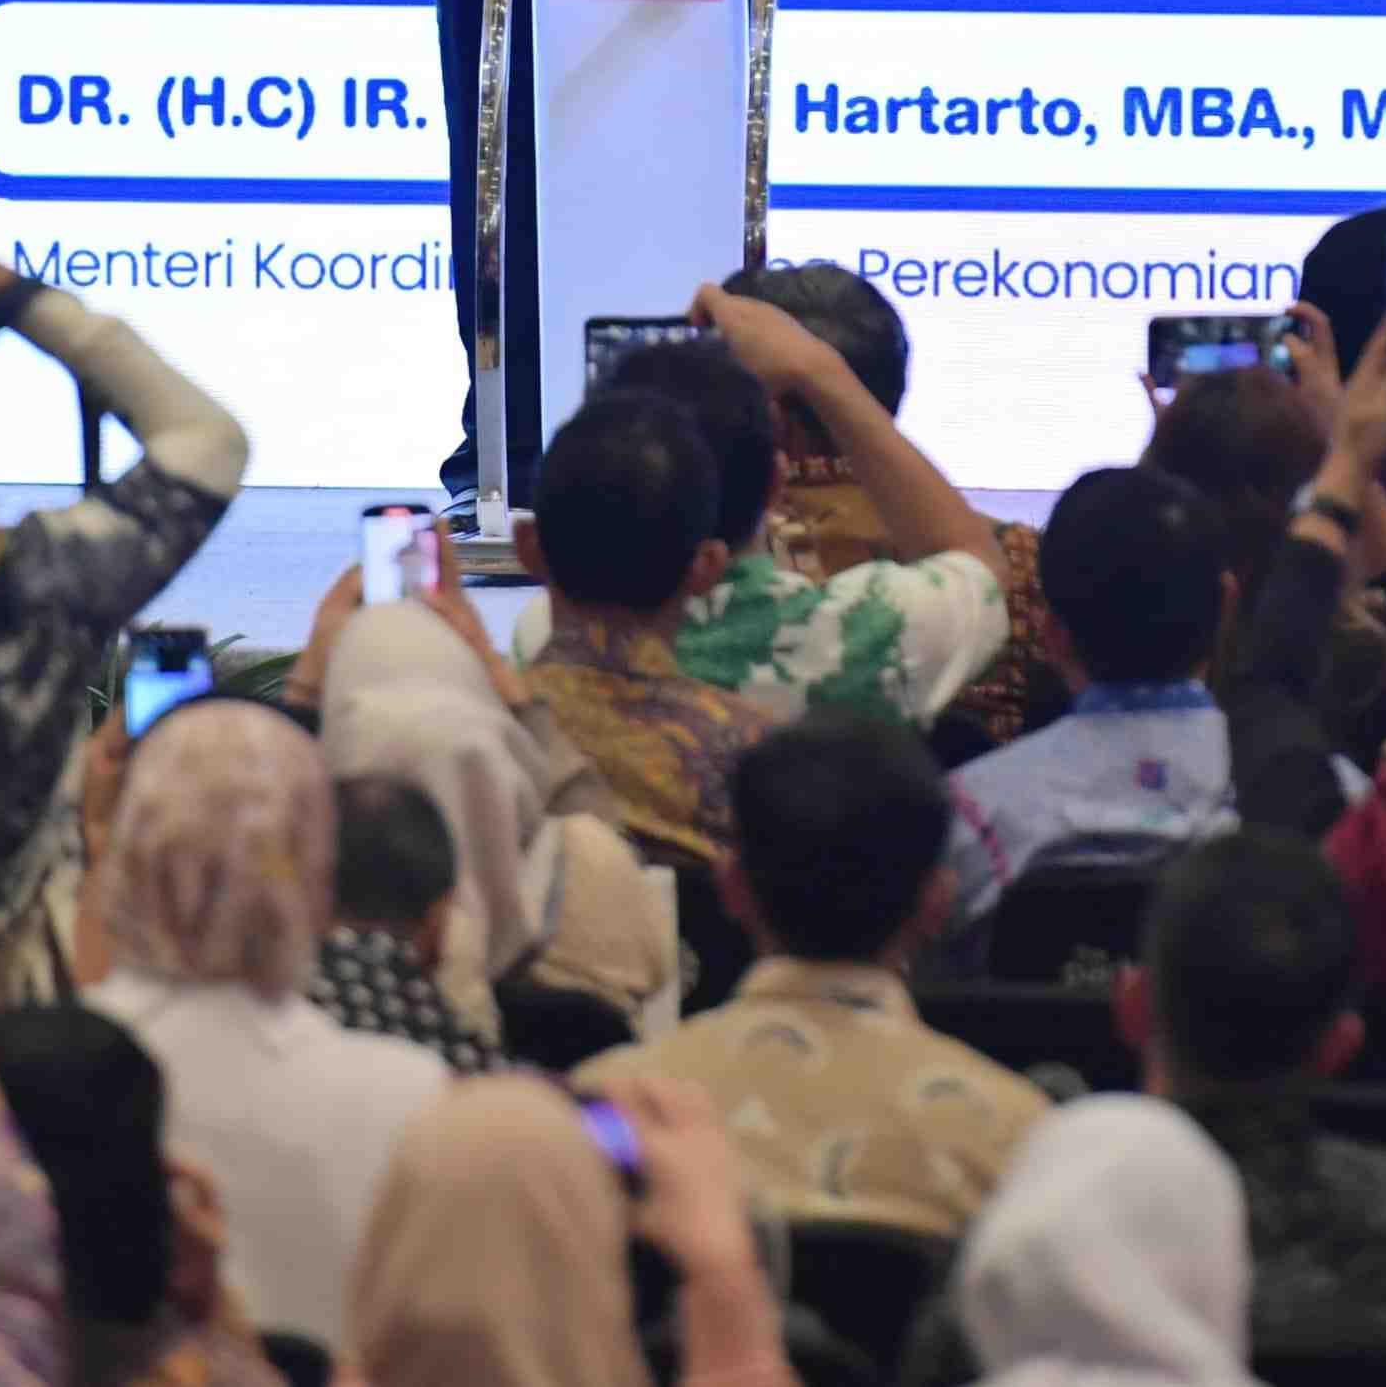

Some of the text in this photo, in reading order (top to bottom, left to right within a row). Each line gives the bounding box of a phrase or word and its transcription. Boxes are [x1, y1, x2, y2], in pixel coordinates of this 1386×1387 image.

[18, 74, 427, 140] DR. (H.C) IR.
[793, 82, 1100, 149] Hartarto,
[1122, 85, 1314, 152] MBA.,
[13, 238, 233, 288] Menteri
[255, 241, 454, 290] Koordi
[859, 248, 1298, 300] Perekonomian
